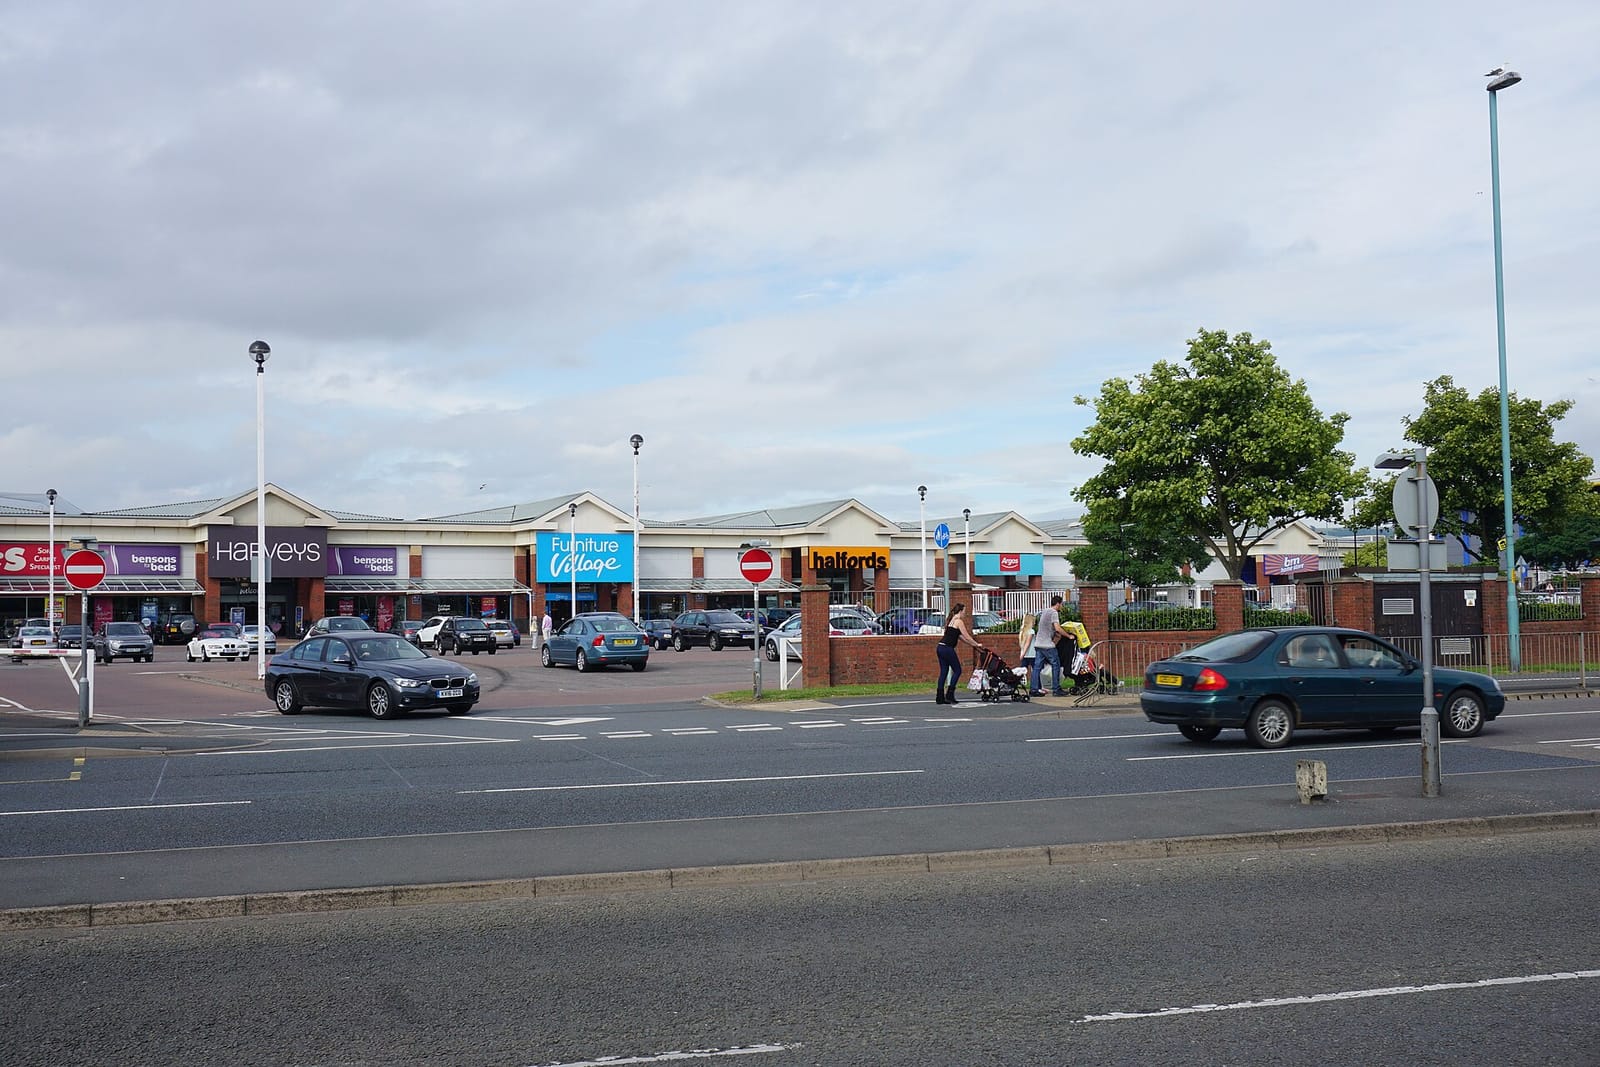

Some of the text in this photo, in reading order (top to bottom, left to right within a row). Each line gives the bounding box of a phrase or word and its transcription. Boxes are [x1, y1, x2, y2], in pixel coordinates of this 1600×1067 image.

[0, 547, 26, 571] S
[131, 554, 177, 564] bensons
[353, 555, 394, 564] bensons
[813, 551, 887, 569] halfords
[1001, 557, 1019, 566] Argos
[150, 562, 177, 571] beds
[370, 563, 394, 572] beds
[550, 553, 622, 578] Village
